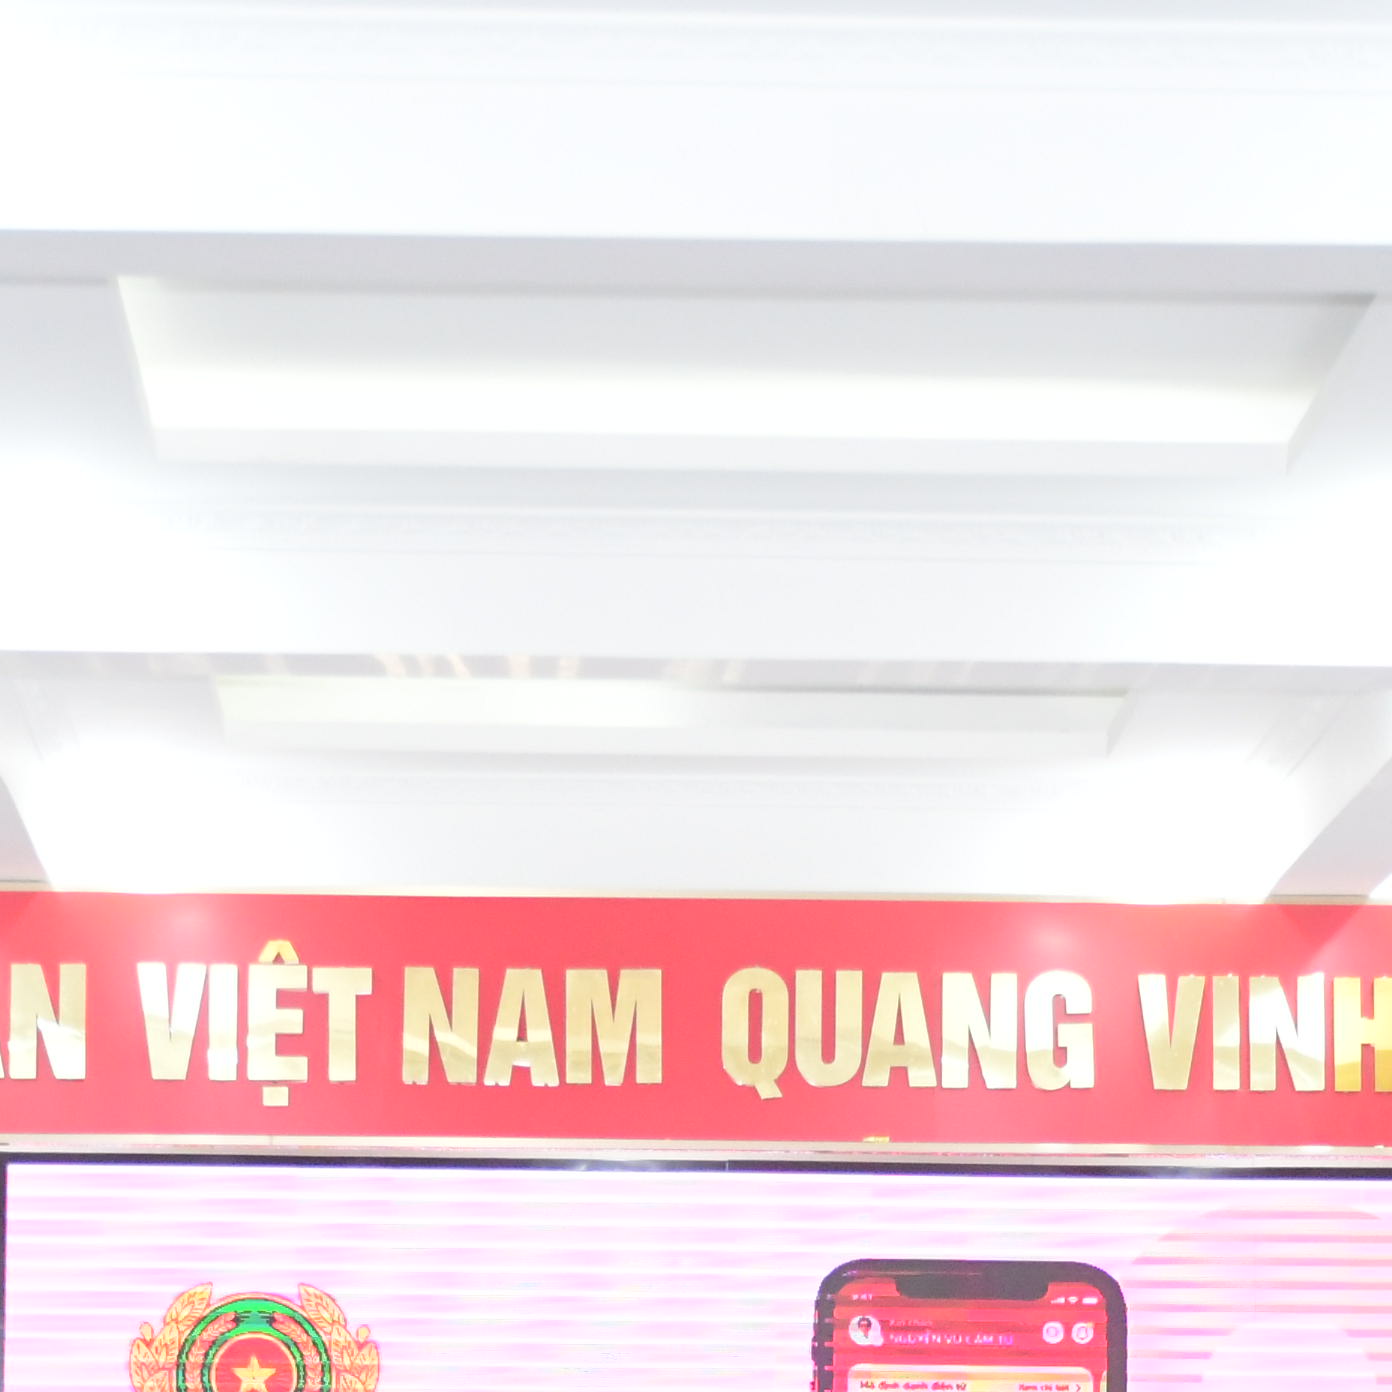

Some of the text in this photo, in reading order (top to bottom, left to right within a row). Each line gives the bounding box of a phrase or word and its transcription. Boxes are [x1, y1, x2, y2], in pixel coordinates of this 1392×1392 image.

[136, 939, 373, 1107] VIỆT
[401, 966, 663, 1087] NAM
[721, 966, 1095, 1099] QUANG
